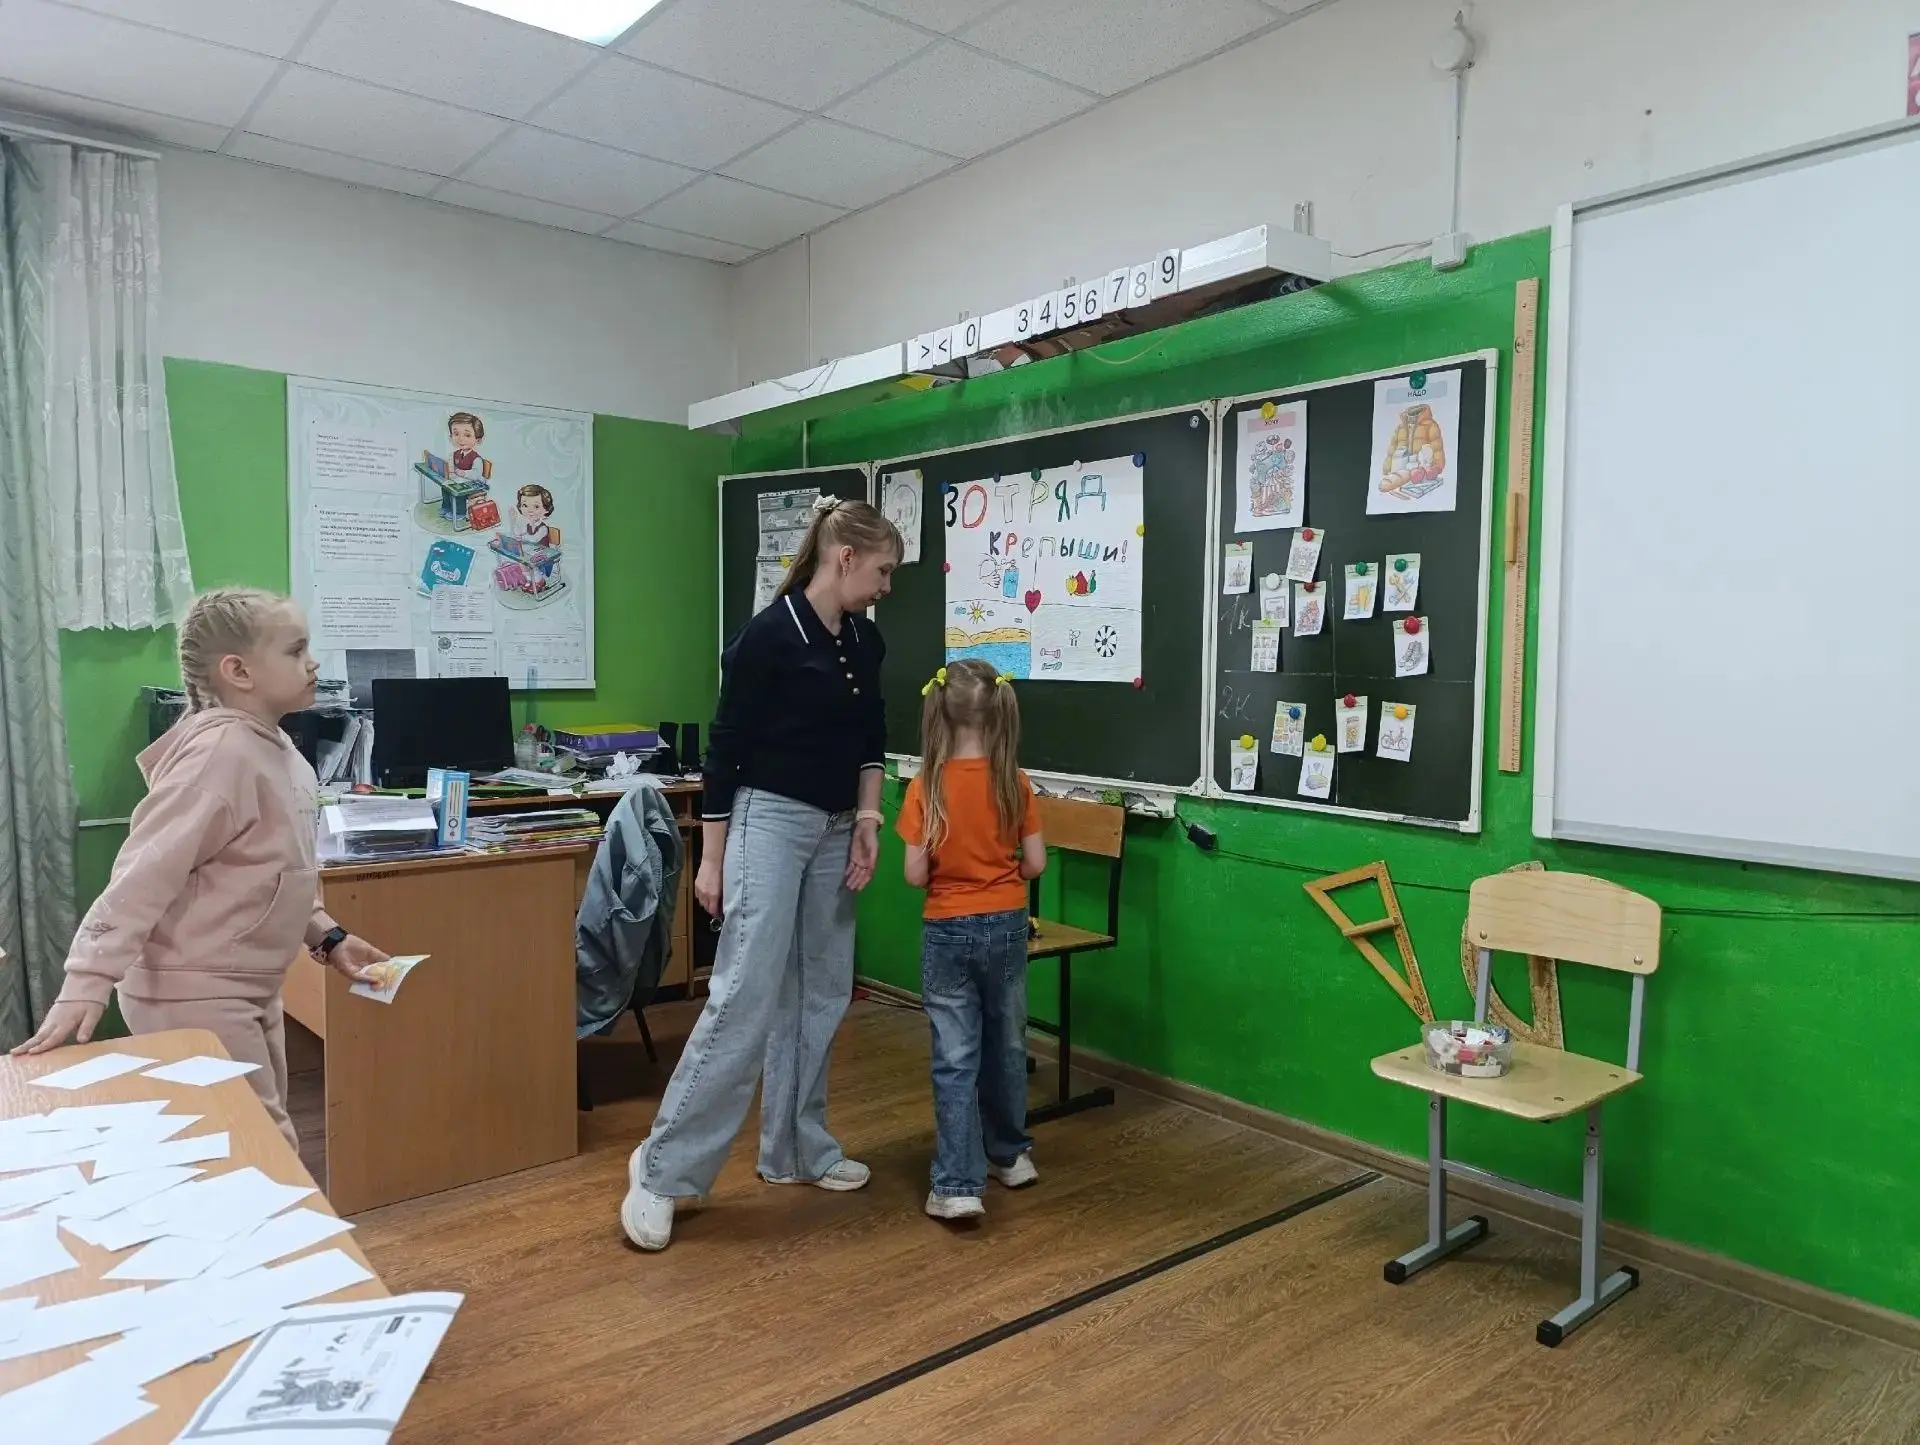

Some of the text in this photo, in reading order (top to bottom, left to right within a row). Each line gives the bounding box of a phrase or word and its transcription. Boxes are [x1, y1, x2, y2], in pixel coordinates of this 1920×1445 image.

[966, 323, 976, 347] 0
[1018, 308, 1028, 333] 3
[1039, 299, 1051, 325] 4
[1064, 292, 1076, 319] 5
[1085, 289, 1097, 315] 6
[1112, 276, 1125, 303] 7
[1134, 271, 1147, 299] 8
[1162, 255, 1175, 284] 9
